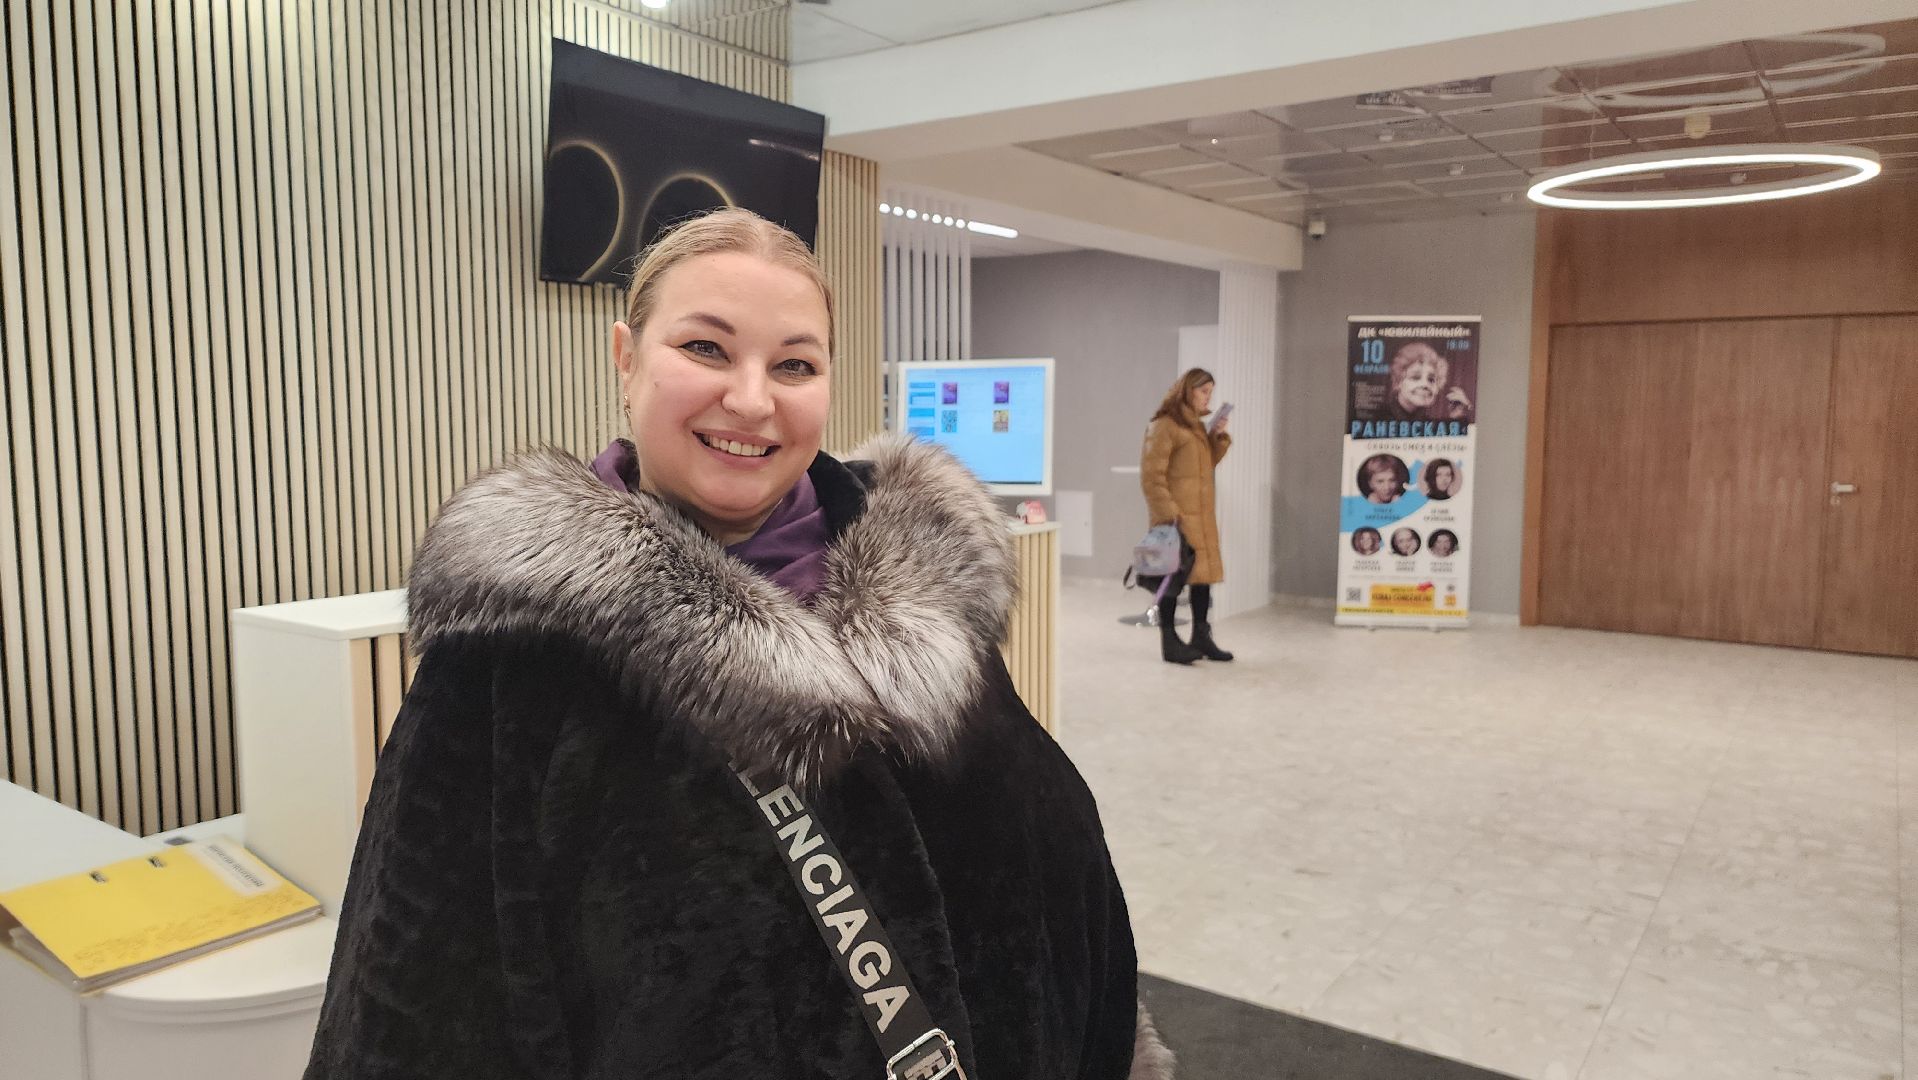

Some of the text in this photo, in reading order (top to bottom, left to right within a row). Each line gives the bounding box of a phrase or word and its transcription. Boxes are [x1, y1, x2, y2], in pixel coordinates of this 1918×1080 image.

[1357, 327, 1377, 338] ДК
[1361, 339, 1385, 363] 10
[728, 761, 911, 1034] LENCIAGA
